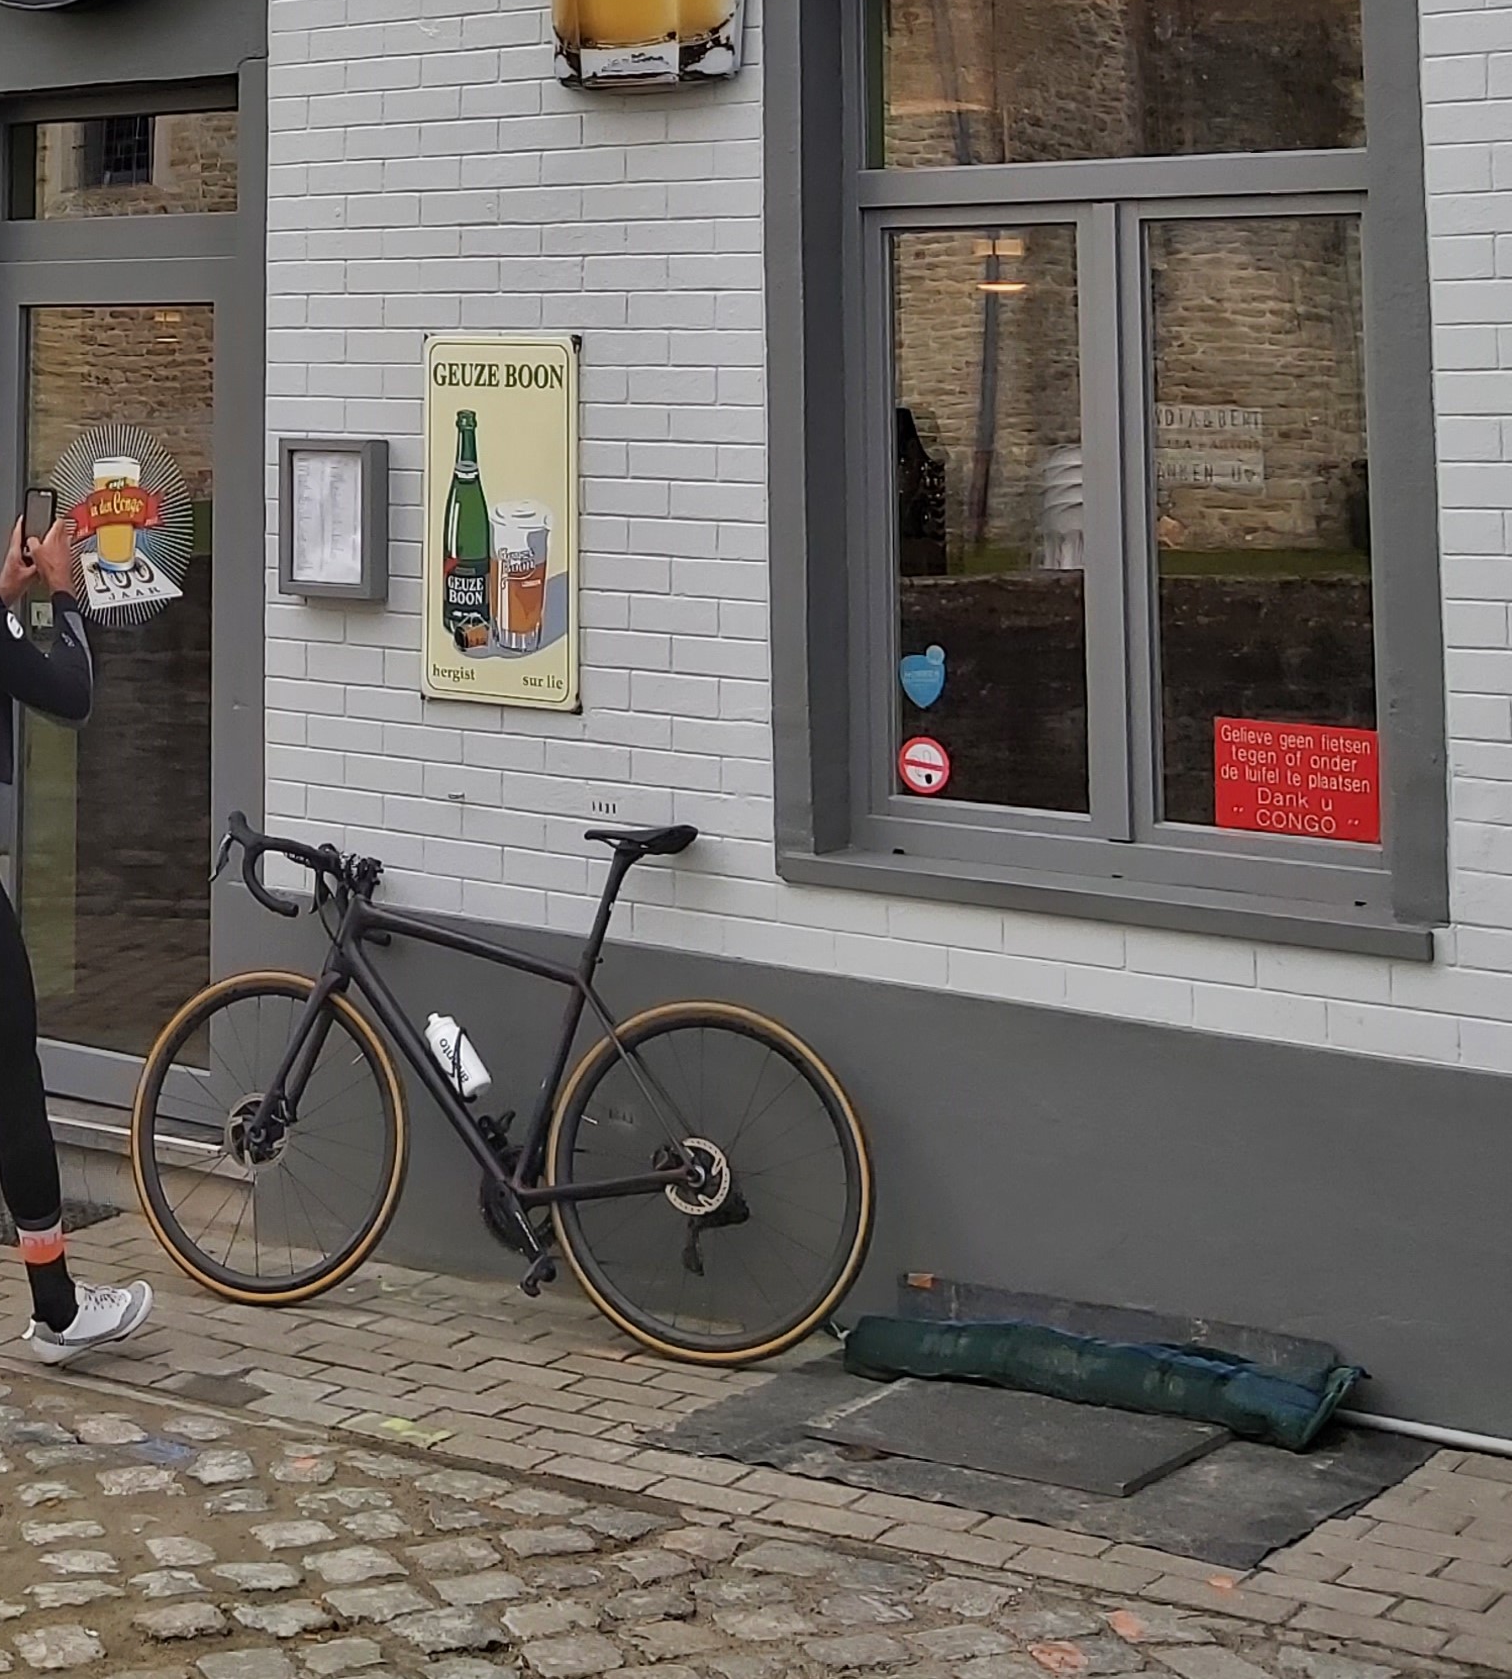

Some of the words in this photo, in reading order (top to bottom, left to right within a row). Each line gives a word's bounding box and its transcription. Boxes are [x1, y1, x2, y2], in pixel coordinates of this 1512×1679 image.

[433, 362, 500, 388] GEUZE
[504, 363, 565, 389] BOON
[108, 586, 161, 601] JAAR
[447, 575, 484, 592] GEUZE
[448, 589, 483, 605] BOON
[432, 664, 475, 683] hergist
[522, 675, 544, 688] sur
[1221, 724, 1273, 746] Gelieve
[1279, 733, 1314, 750] geen
[1321, 734, 1371, 755] fietsen
[1232, 745, 1277, 766] tegen
[1285, 751, 1302, 767] of
[1310, 755, 1358, 772] onder
[1221, 764, 1238, 780] de
[1245, 765, 1279, 784] luifel
[1287, 772, 1302, 787] te
[1308, 773, 1371, 794] plaatsen
[1257, 787, 1309, 809] Dank
[1321, 797, 1333, 812] u
[1256, 809, 1337, 834] CONGO
